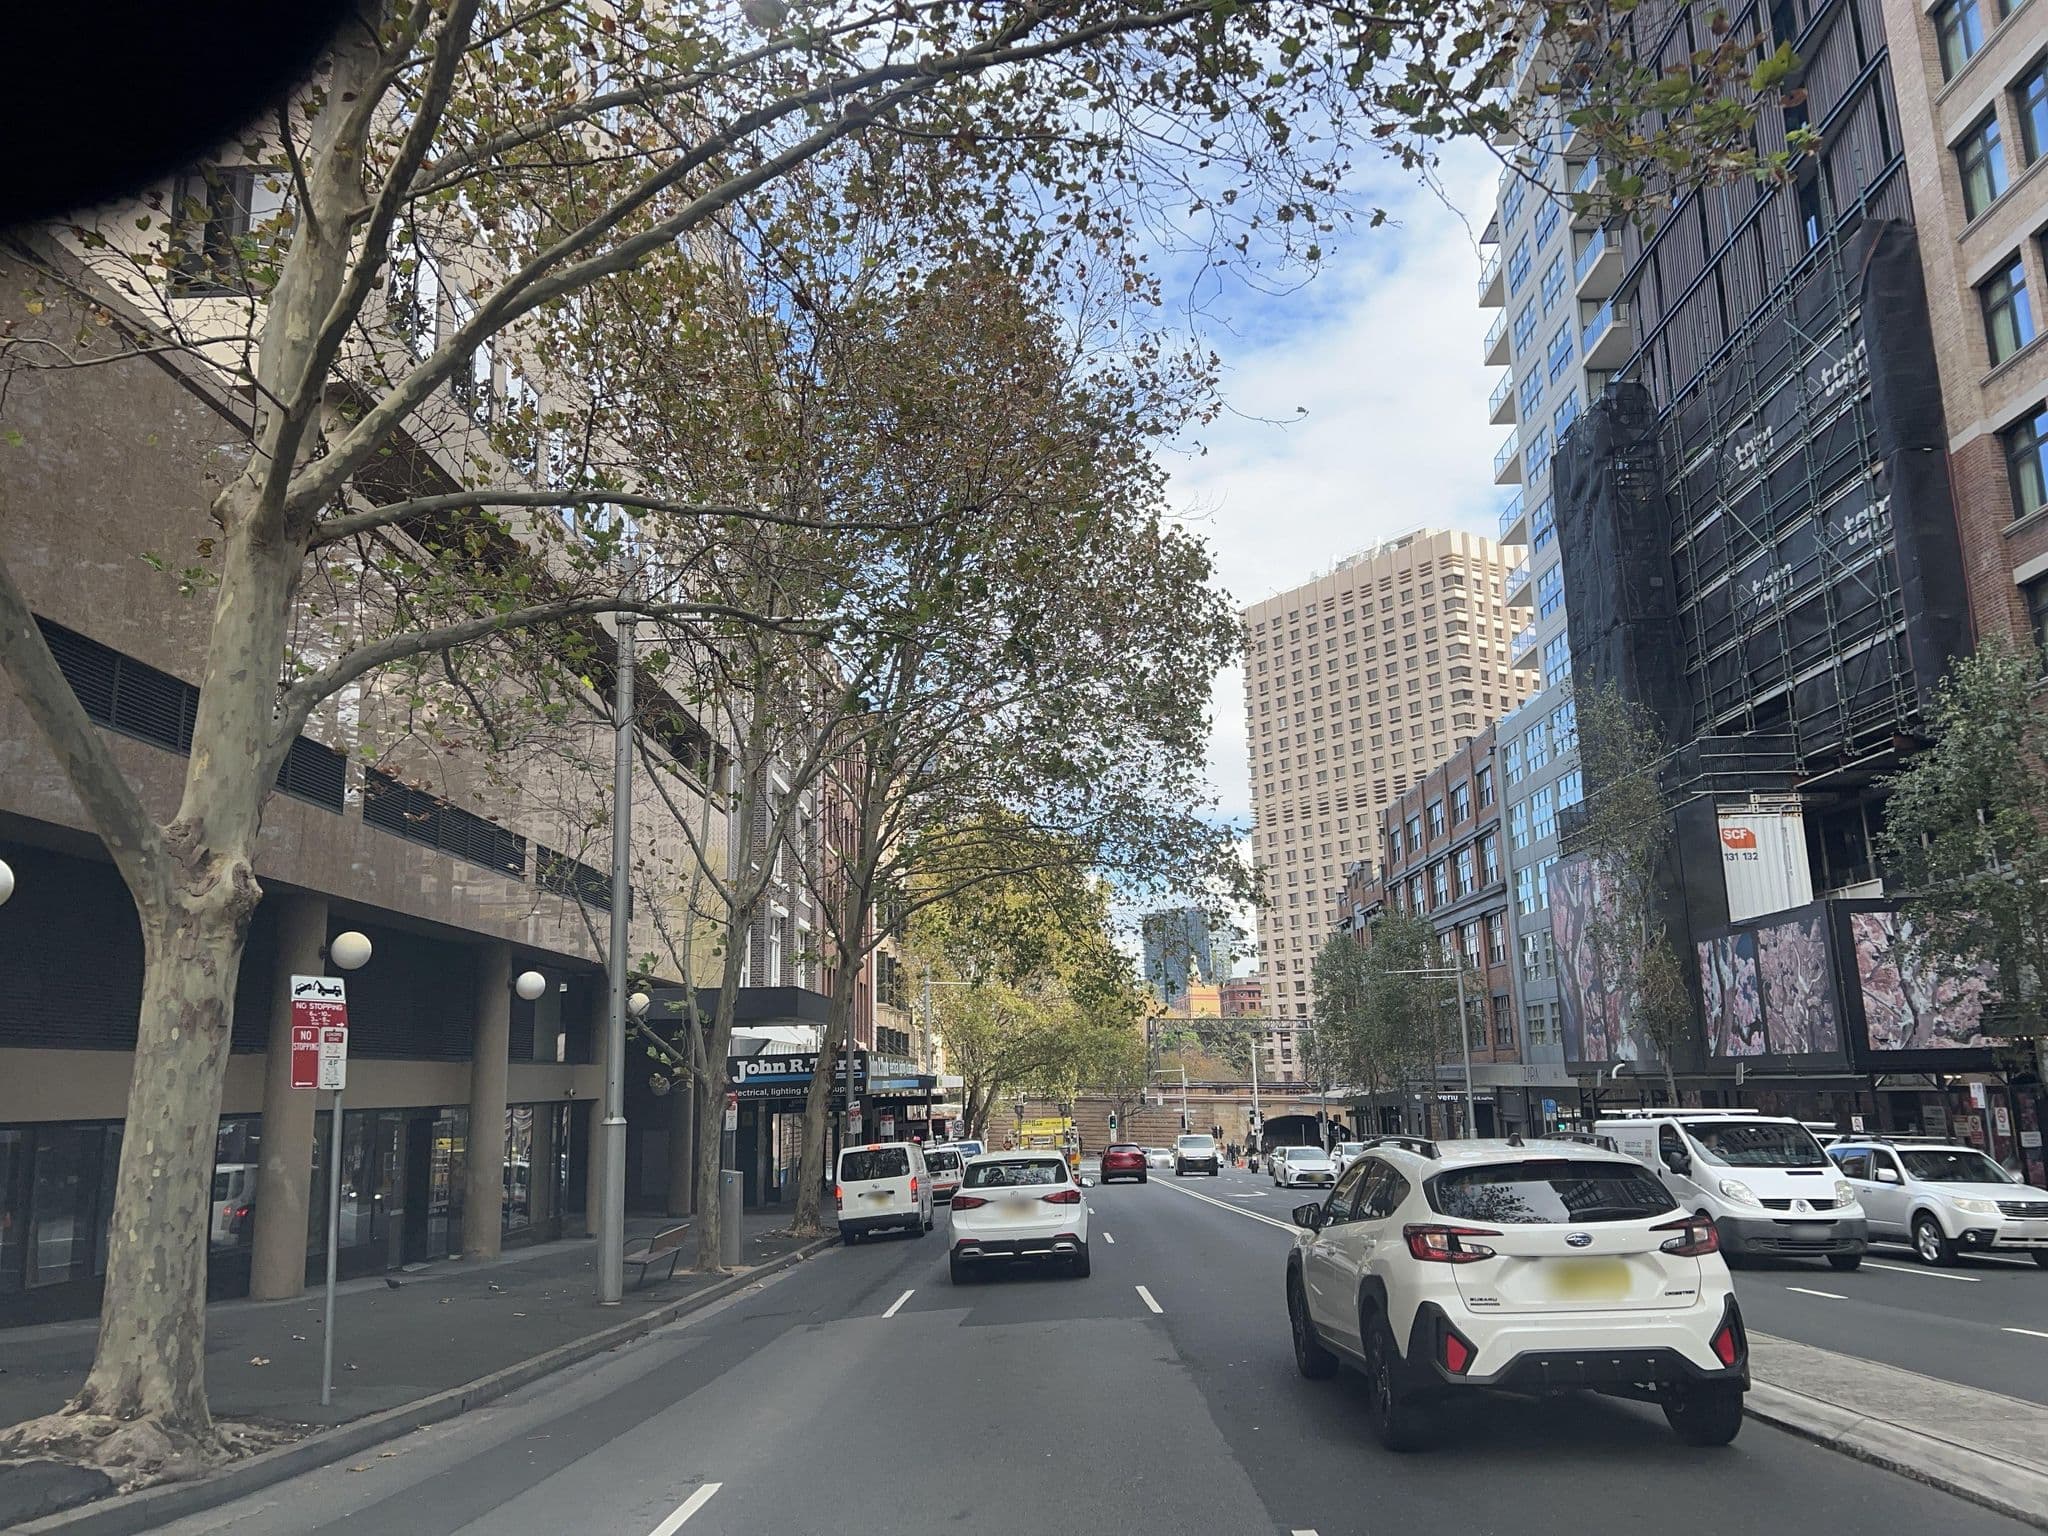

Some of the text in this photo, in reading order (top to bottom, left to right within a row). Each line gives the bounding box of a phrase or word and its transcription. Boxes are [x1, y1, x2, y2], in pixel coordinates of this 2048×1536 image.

[1723, 829, 1748, 840] SCF
[1724, 852, 1759, 861] 131 132
[296, 1002, 343, 1011] NO STOPPING
[300, 1030, 312, 1041] NO
[732, 1059, 787, 1084] John
[771, 1087, 802, 1097] lighting
[803, 1086, 809, 1094] &
